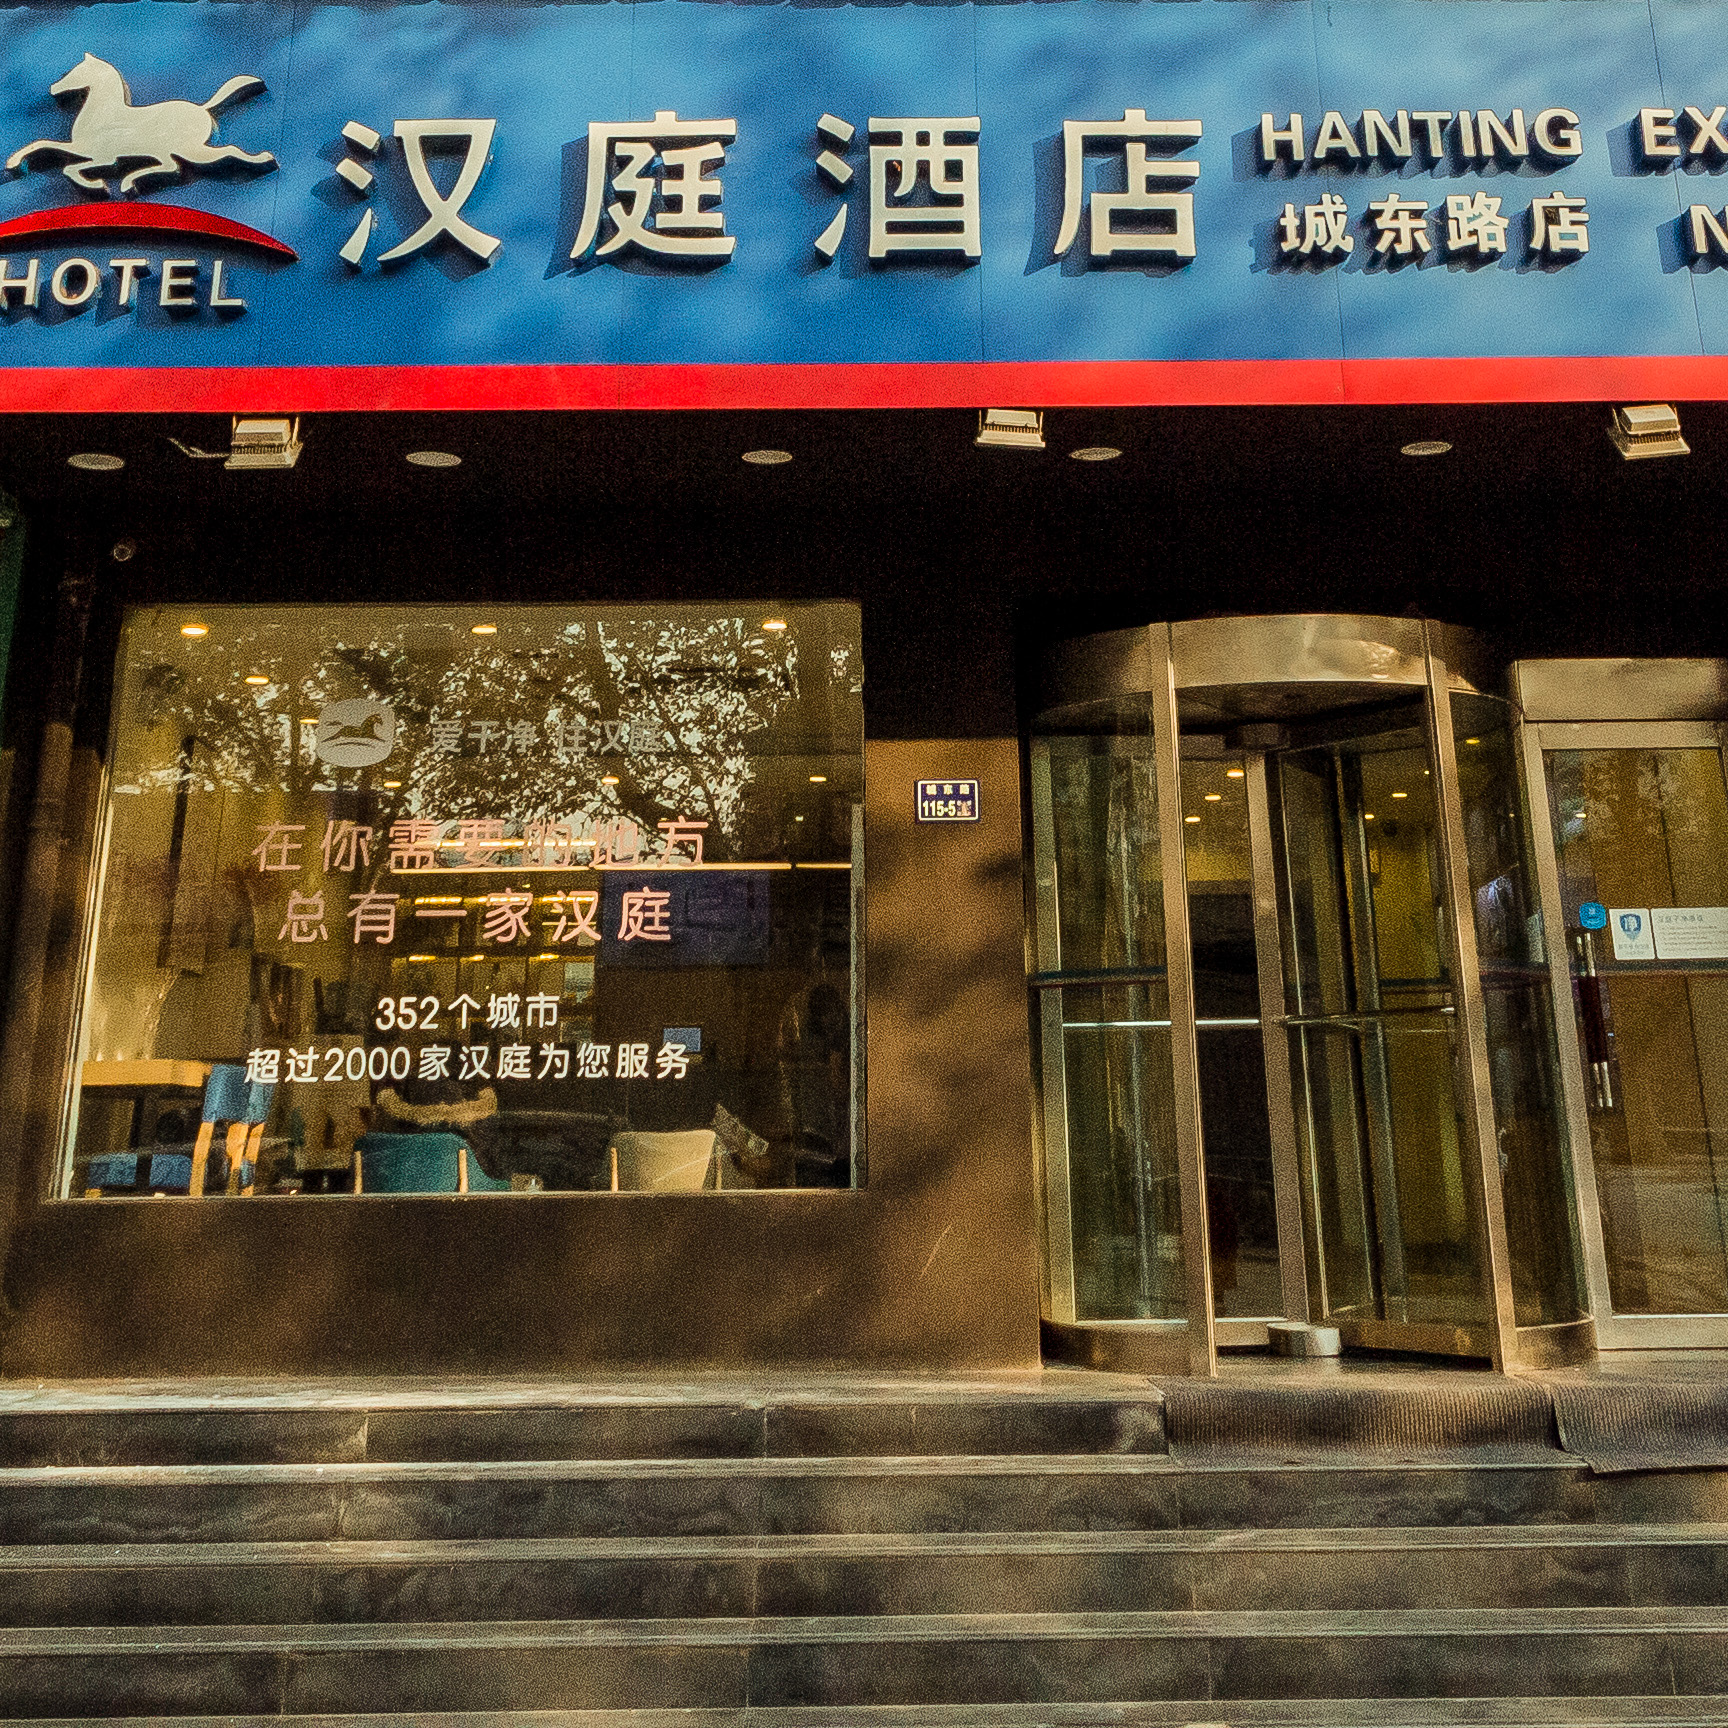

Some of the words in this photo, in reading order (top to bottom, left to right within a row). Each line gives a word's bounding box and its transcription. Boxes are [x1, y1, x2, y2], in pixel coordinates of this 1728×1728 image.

[1260, 106, 1584, 162] HANTING
[336, 109, 1203, 268] 汉庭酒店
[1279, 191, 1592, 256] 城东路店
[251, 817, 710, 874] 在你需要的地方
[277, 887, 673, 945] 总有一家汉庭
[375, 991, 560, 1031] 352个城市
[243, 1042, 691, 1085] 超过2000家汉庭为您服务
